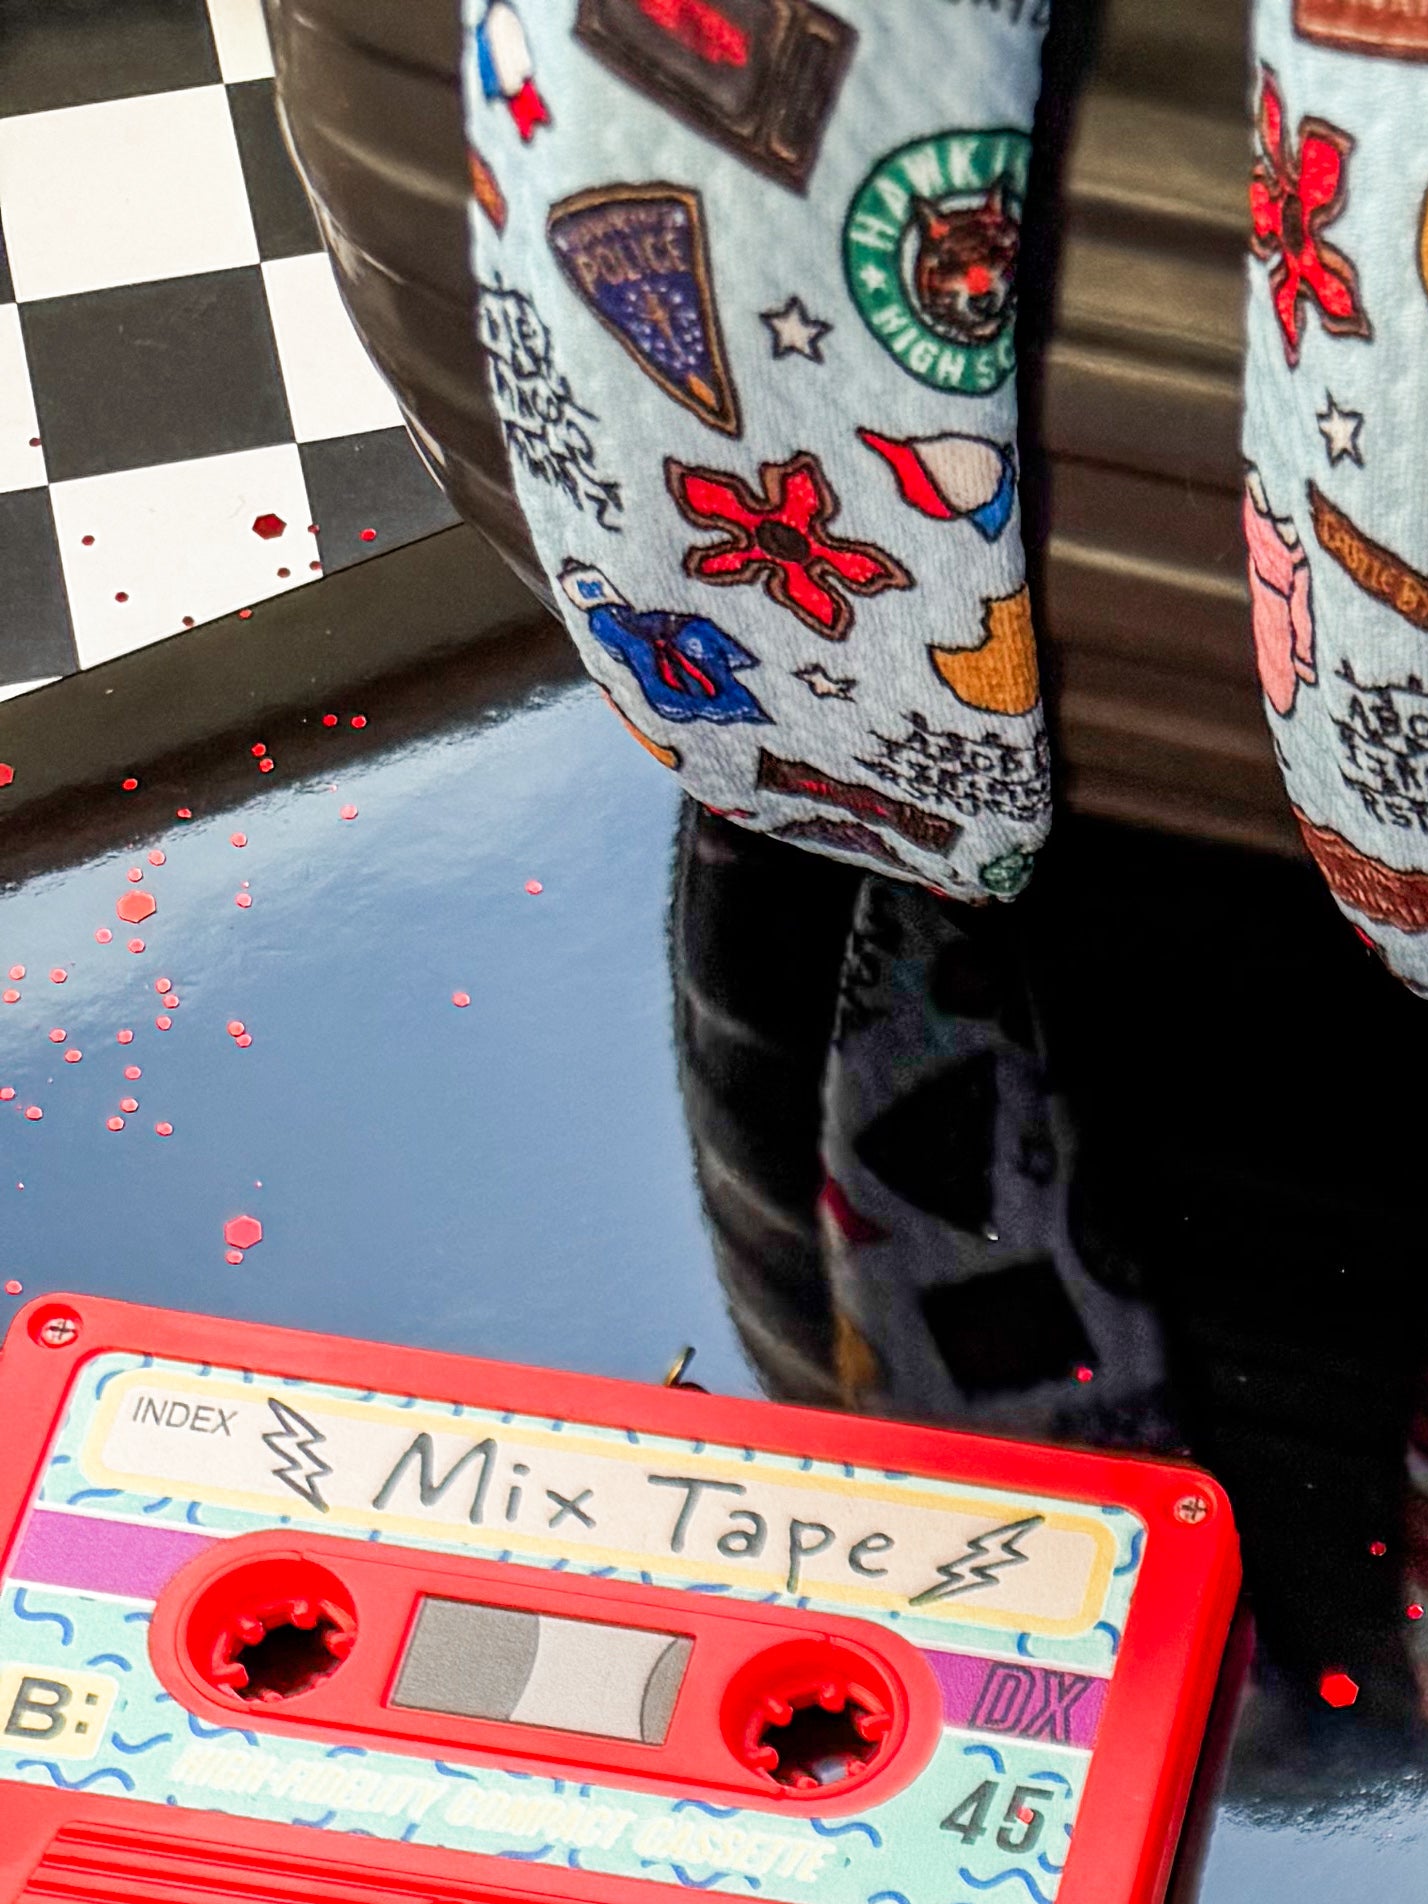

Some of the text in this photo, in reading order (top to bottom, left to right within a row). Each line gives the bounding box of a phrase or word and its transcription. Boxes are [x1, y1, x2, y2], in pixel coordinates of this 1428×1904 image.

[849, 138, 1030, 251] HAWKI
[871, 303, 966, 386] HIGH
[132, 1395, 238, 1438] INDEX
[372, 1432, 897, 1594] Mix Tape
[4, 1676, 99, 1741] B:
[968, 1661, 1096, 1744] DX
[633, 1814, 837, 1882] CASSETTE
[939, 1779, 1055, 1854] 45
